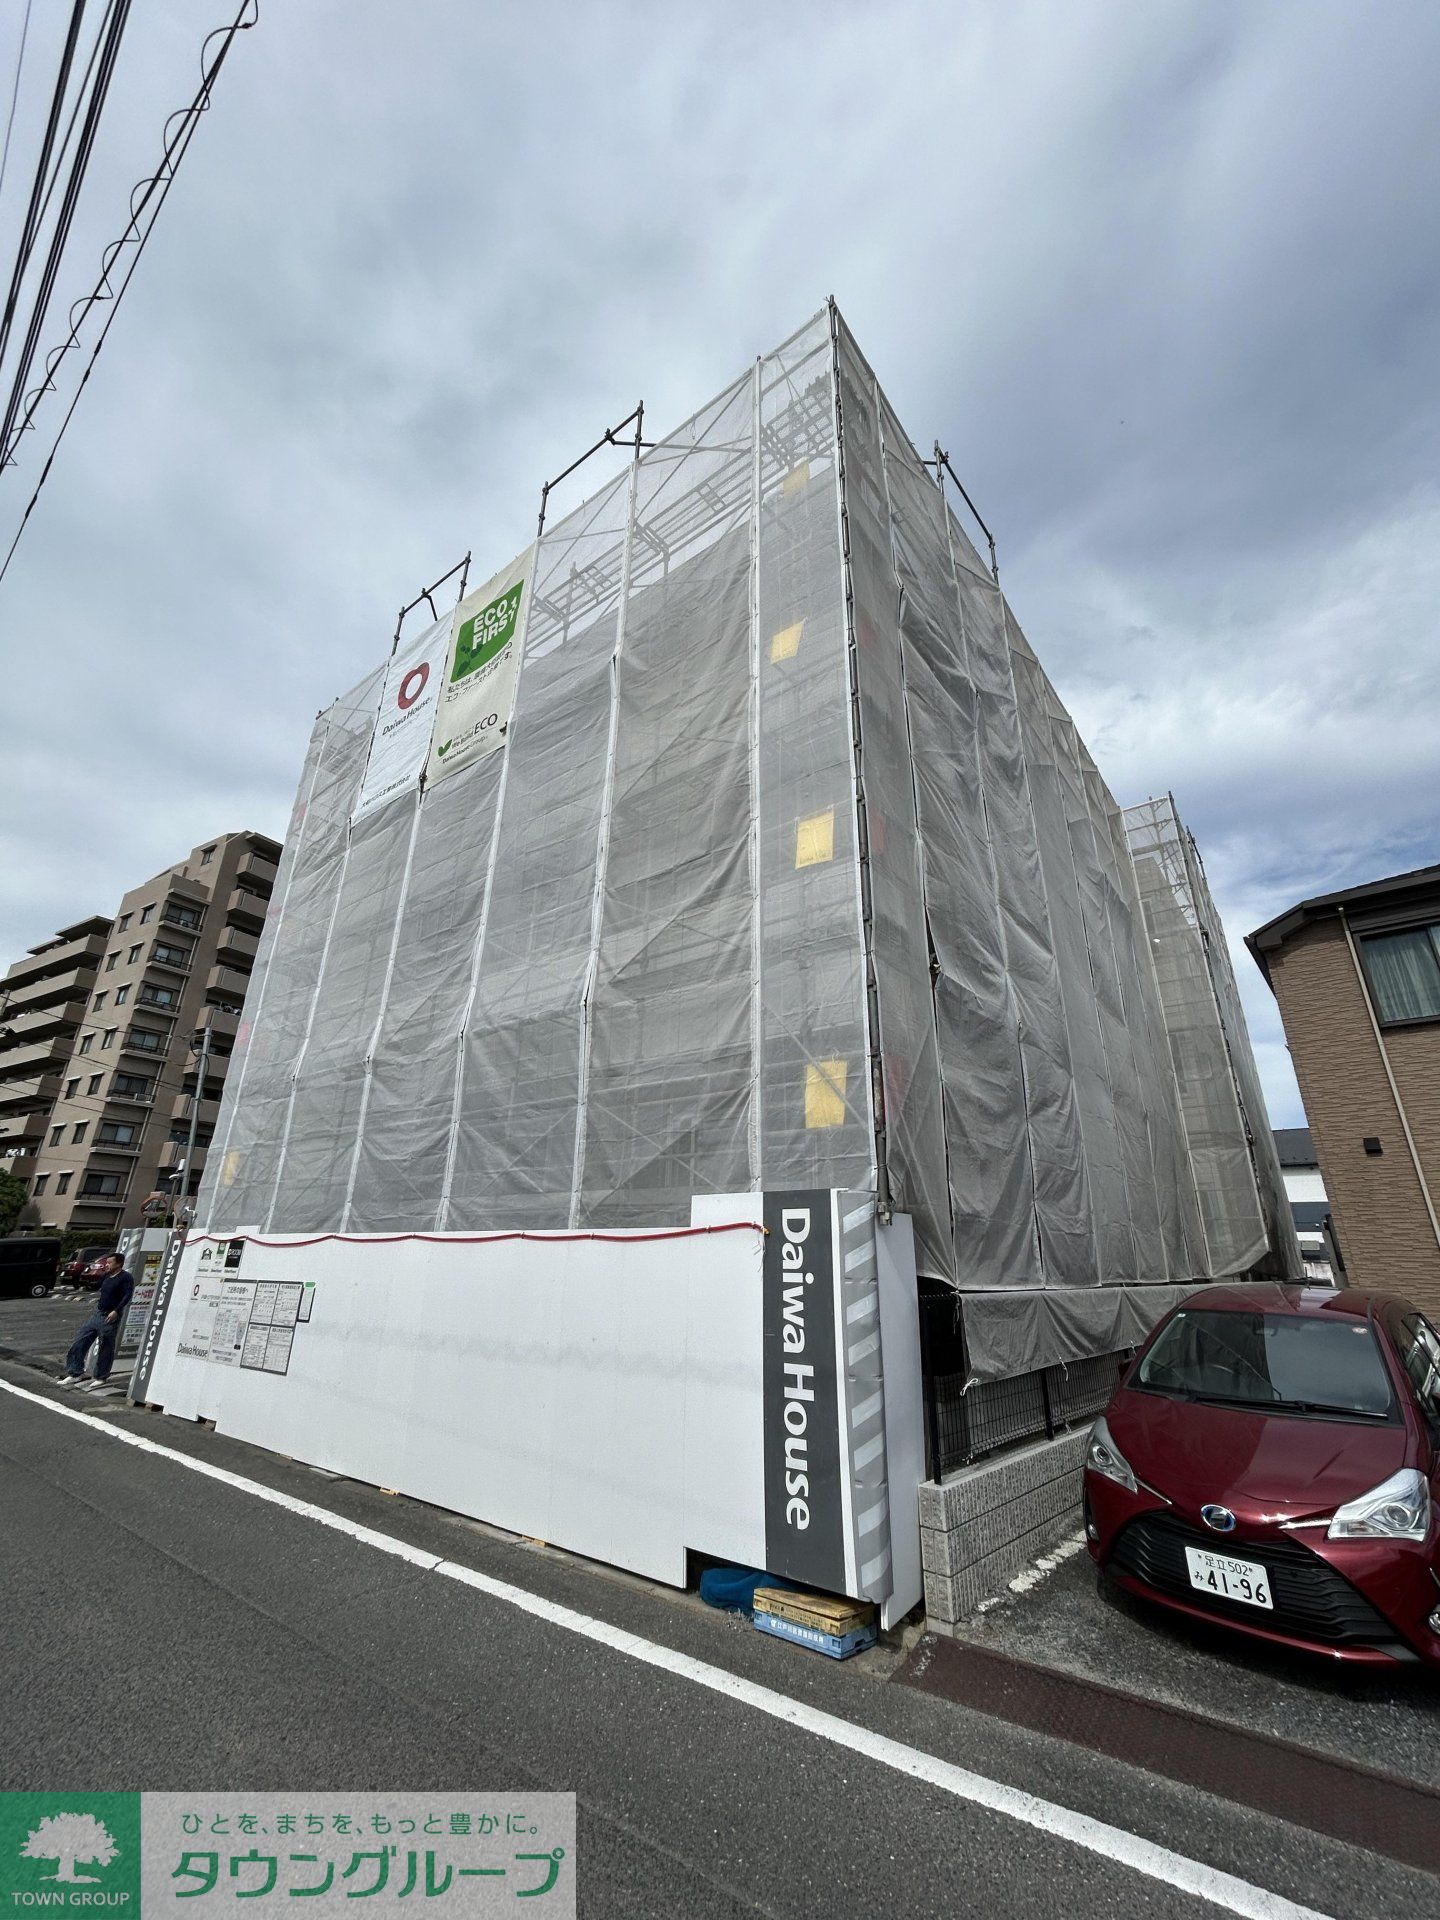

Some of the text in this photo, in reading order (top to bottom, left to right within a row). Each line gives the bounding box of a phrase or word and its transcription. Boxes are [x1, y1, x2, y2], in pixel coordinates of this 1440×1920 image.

[472, 608, 516, 650] FIRST
[473, 599, 508, 634] ECO
[382, 715, 406, 735] Daiwa
[407, 697, 430, 719] House
[475, 713, 498, 735] ECO
[158, 1239, 181, 1306] Daiwa
[139, 1309, 163, 1381] House
[177, 1342, 193, 1356] Daiwa
[192, 1345, 209, 1358] House
[782, 1207, 815, 1531] Daiwa House
[1207, 1569, 1267, 1604] 41-96
